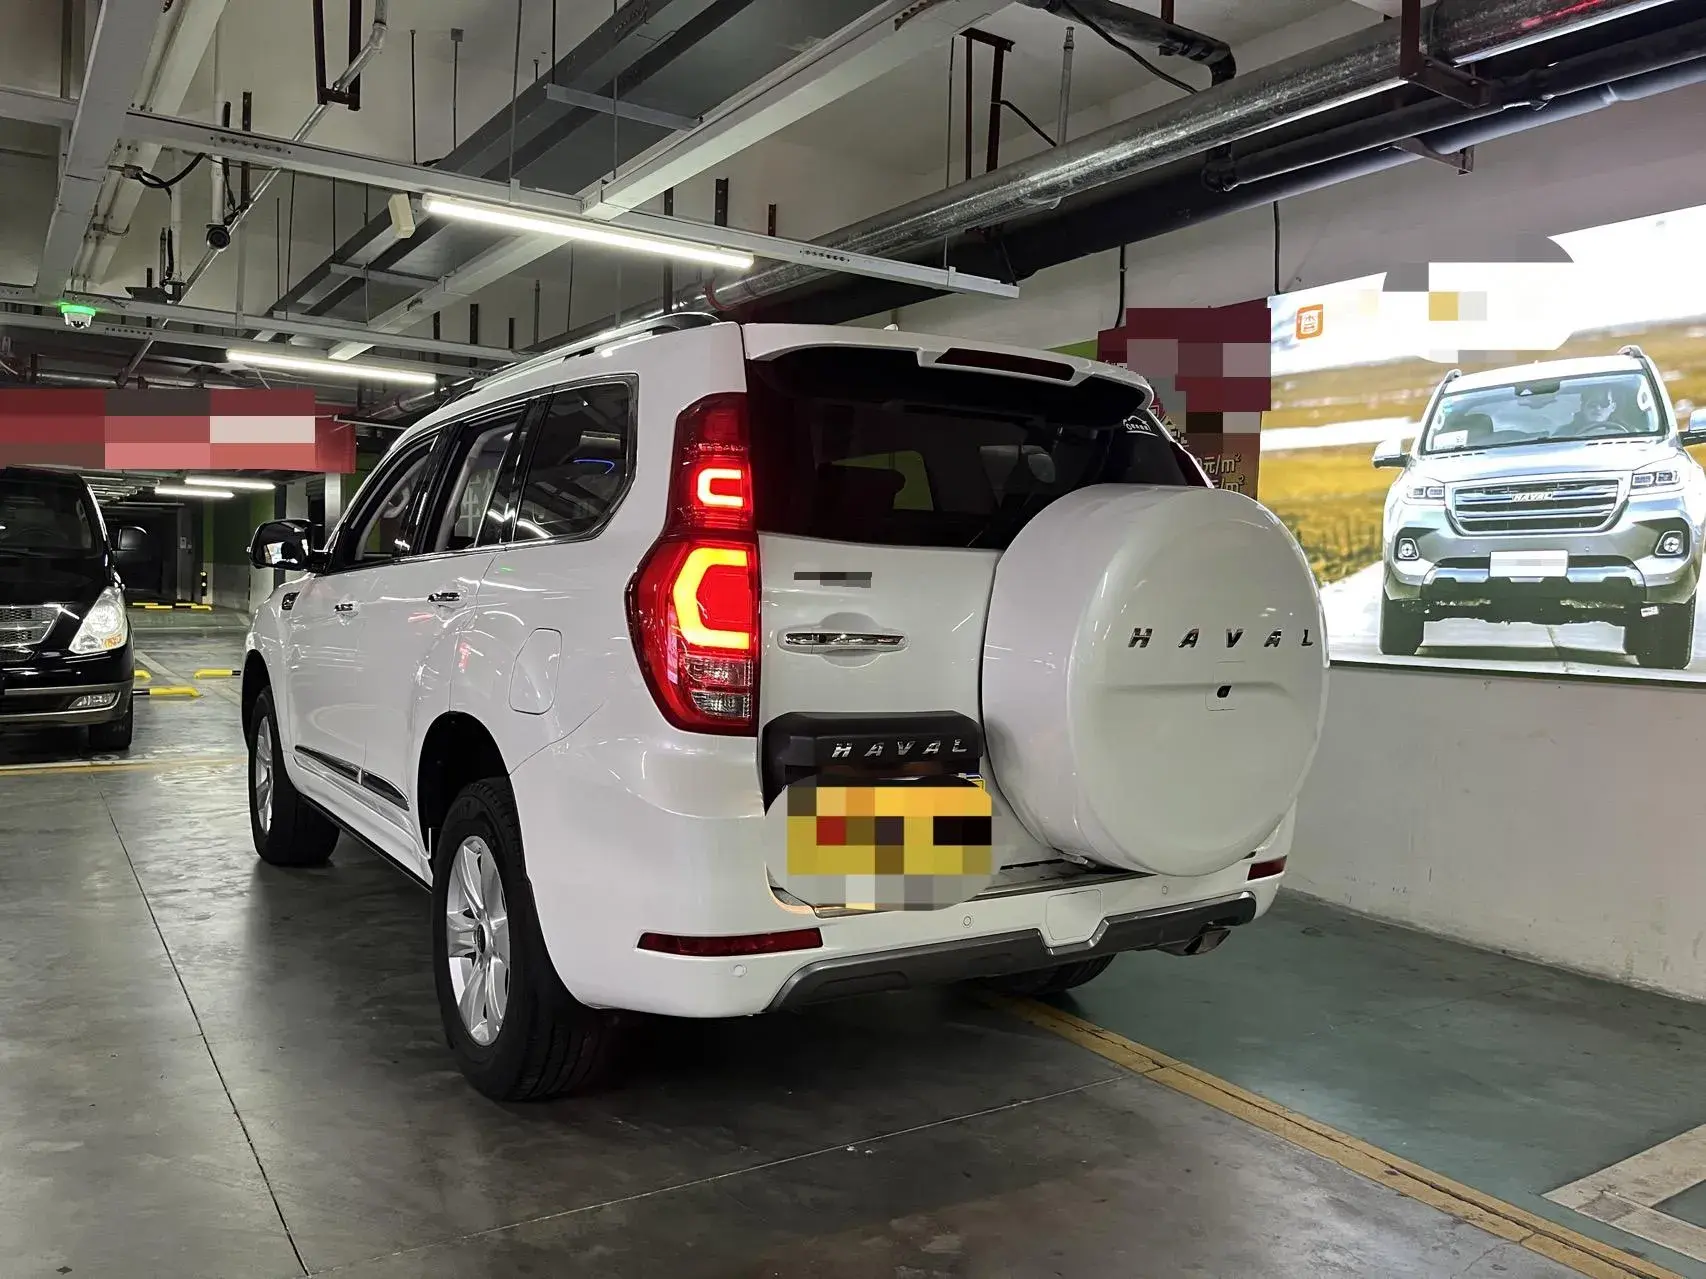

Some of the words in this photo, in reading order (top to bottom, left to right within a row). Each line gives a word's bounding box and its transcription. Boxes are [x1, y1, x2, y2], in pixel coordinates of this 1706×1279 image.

[1512, 491, 1553, 502] HAVAL
[1128, 627, 1314, 648] HAVAL
[832, 739, 967, 758] HAVAL
